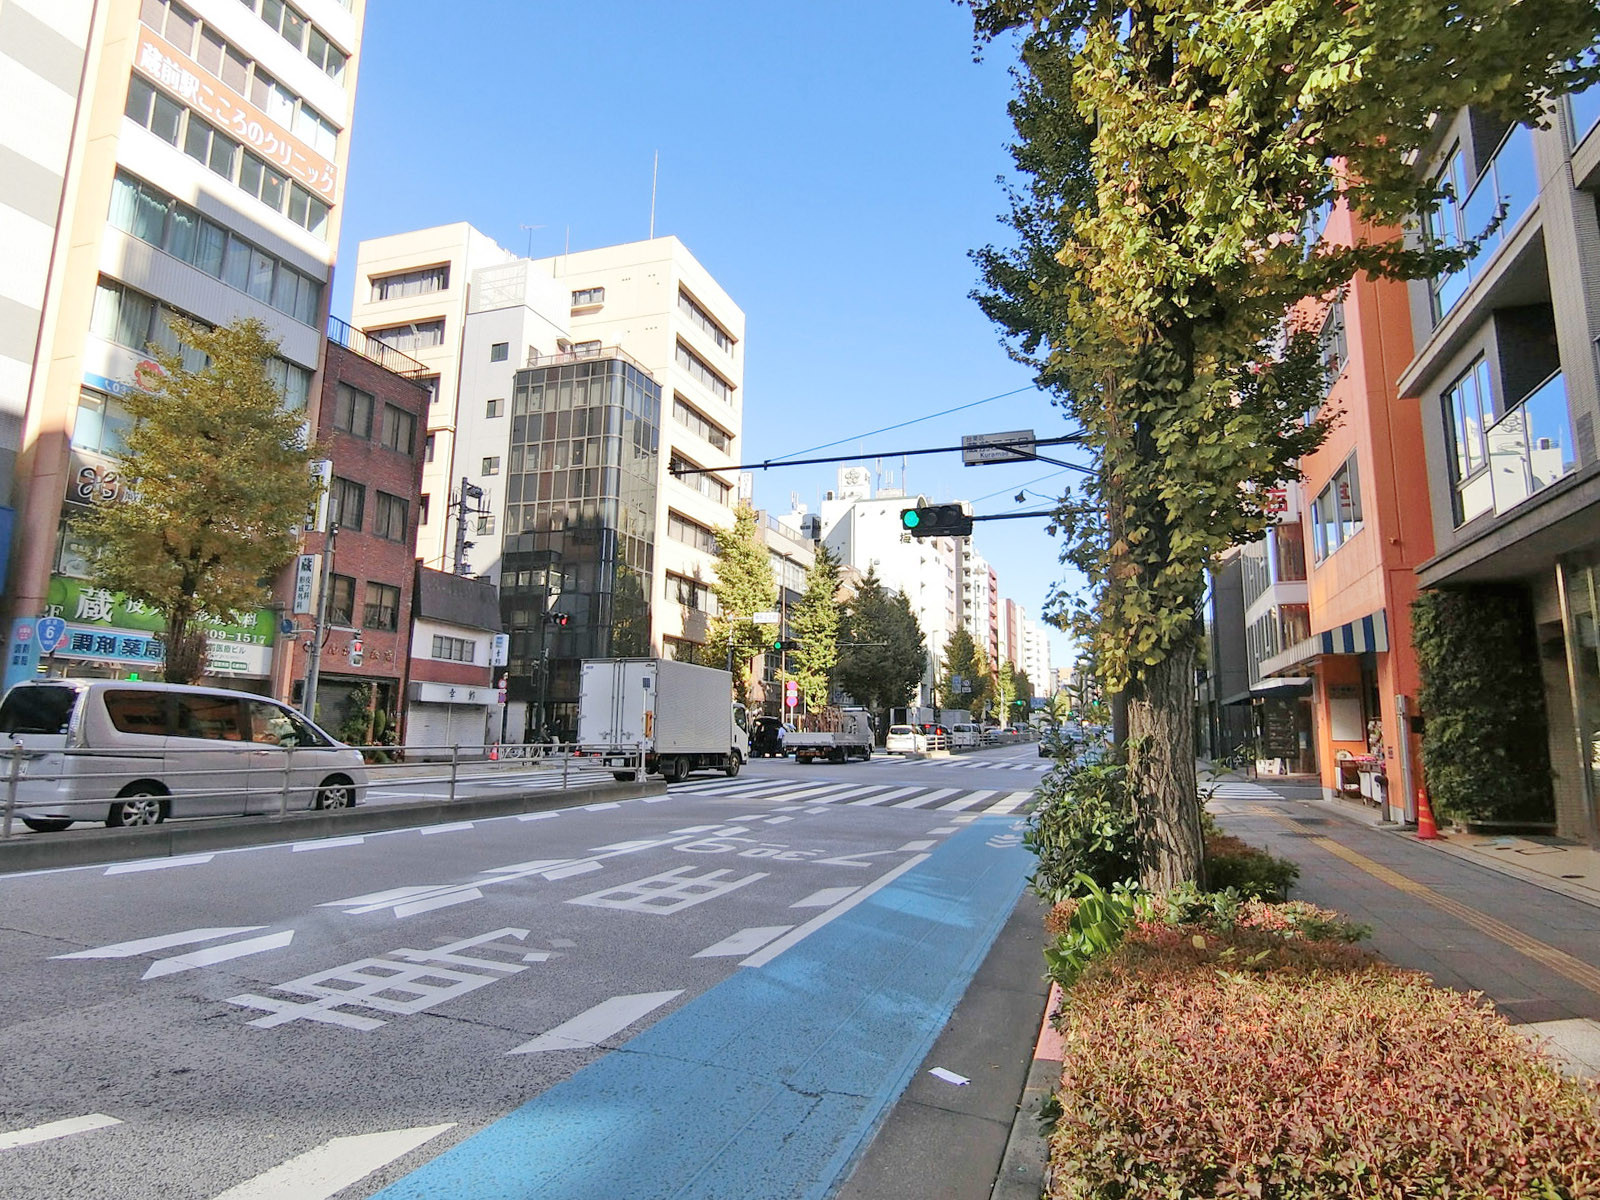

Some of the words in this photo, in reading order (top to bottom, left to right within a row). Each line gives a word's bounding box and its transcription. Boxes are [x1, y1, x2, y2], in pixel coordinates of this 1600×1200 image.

[139, 42, 335, 193] 蔵前駅こころのクリニック
[75, 588, 113, 622] 蔵
[46, 625, 56, 639] 6
[71, 632, 163, 659] 調剤薬局
